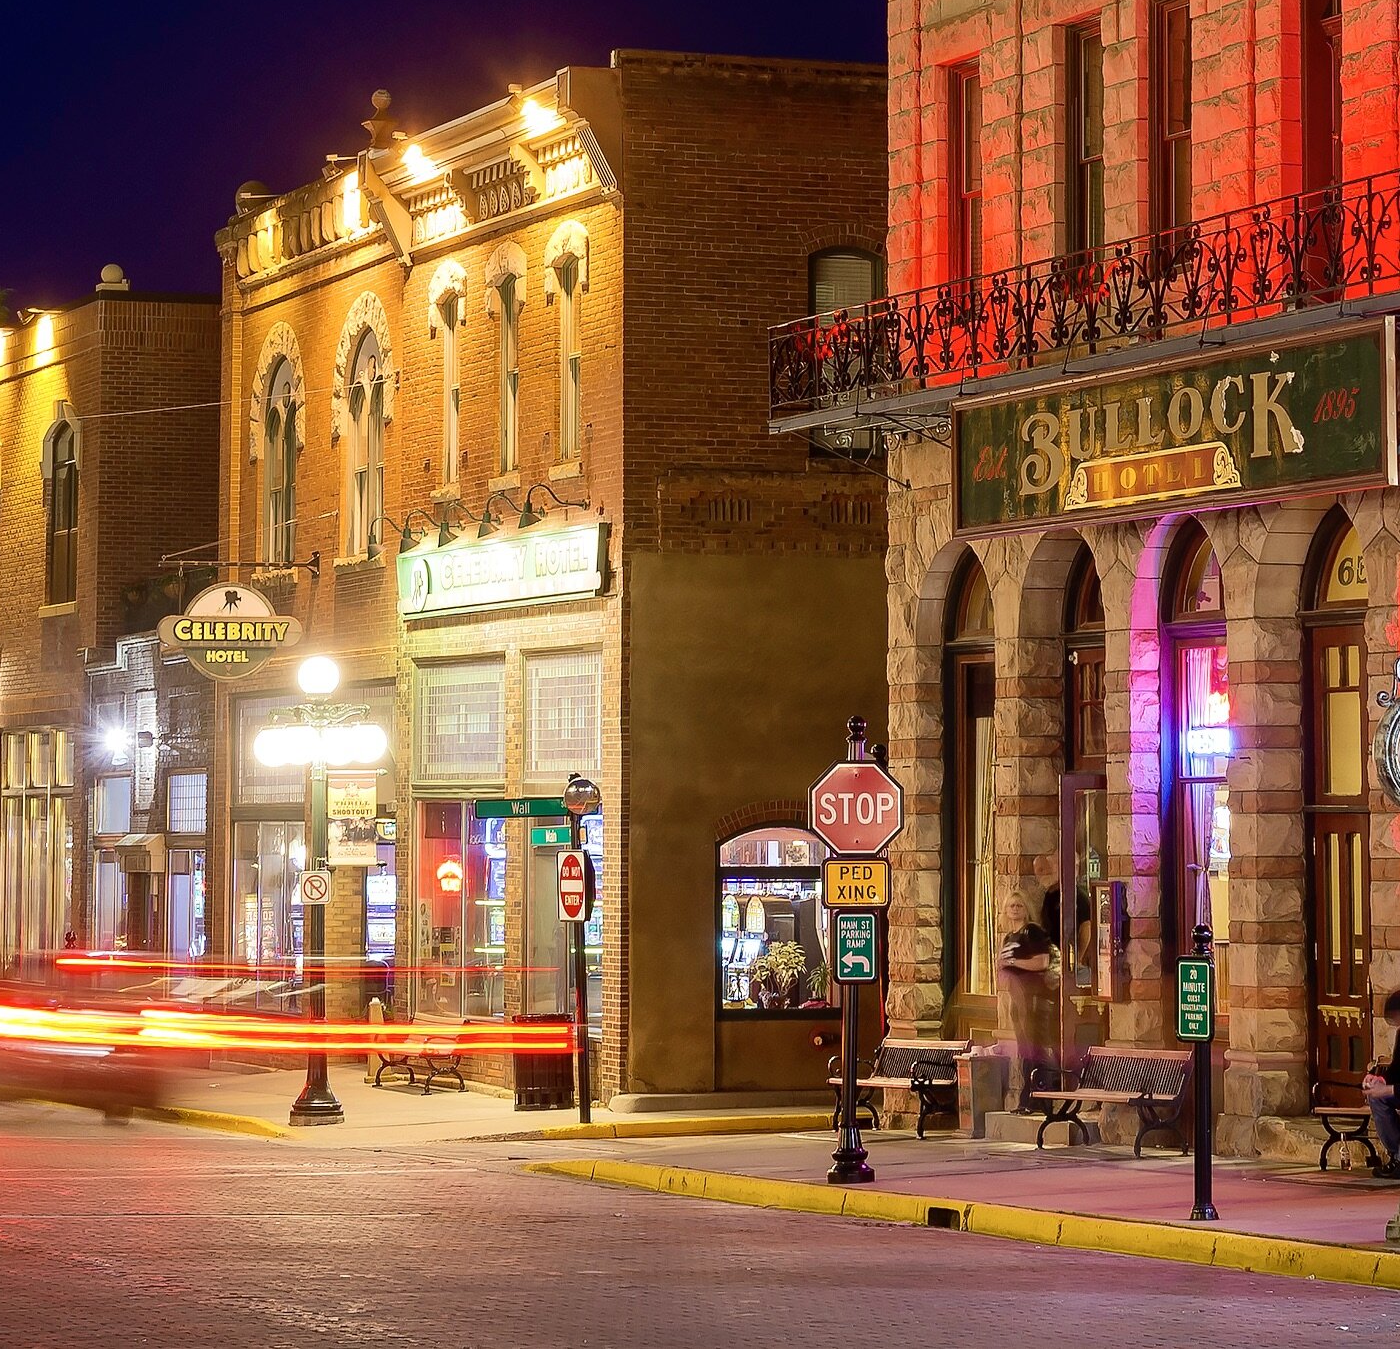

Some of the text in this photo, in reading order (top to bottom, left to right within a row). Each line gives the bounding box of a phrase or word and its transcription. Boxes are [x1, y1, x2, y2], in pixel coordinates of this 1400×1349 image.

[1313, 386, 1361, 424] 1895
[1020, 371, 1305, 495] BULLOCK
[440, 544, 527, 590] CELEBRITY
[534, 537, 589, 577] HOTEL
[174, 619, 289, 642] CELEBRITY
[205, 650, 249, 663] HOTEL
[511, 801, 530, 814] Wall
[819, 792, 894, 826] STOP
[562, 865, 581, 877] DO NOT
[840, 866, 873, 880] PED
[837, 885, 877, 901] XING
[564, 895, 580, 906] ENTER
[841, 921, 858, 930] MAIN
[841, 930, 871, 939] PARKING
[846, 939, 866, 948] RAMP
[1189, 969, 1198, 980] 20
[1182, 982, 1205, 993] MINUTE
[1185, 1013, 1203, 1021] PARKING
[1188, 1022, 1199, 1030] ONLY
